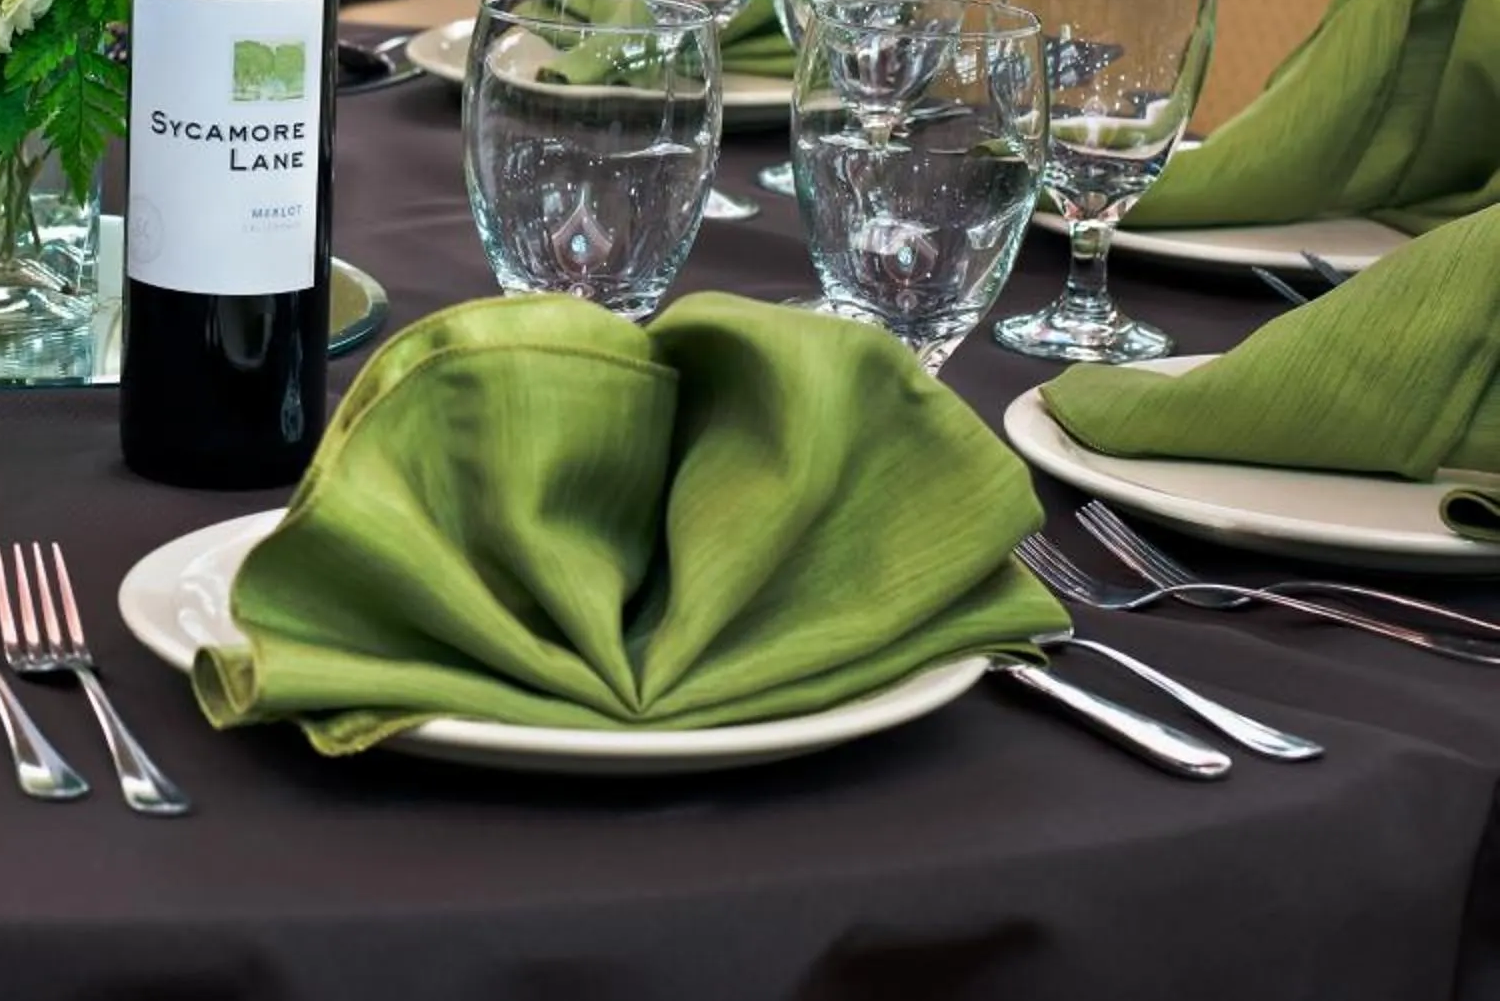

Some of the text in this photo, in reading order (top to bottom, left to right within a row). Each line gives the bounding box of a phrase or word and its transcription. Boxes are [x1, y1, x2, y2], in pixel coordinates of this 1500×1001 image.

[151, 110, 305, 142] SYCAMORE
[231, 148, 304, 172] LANE
[252, 204, 302, 219] MERLOT
